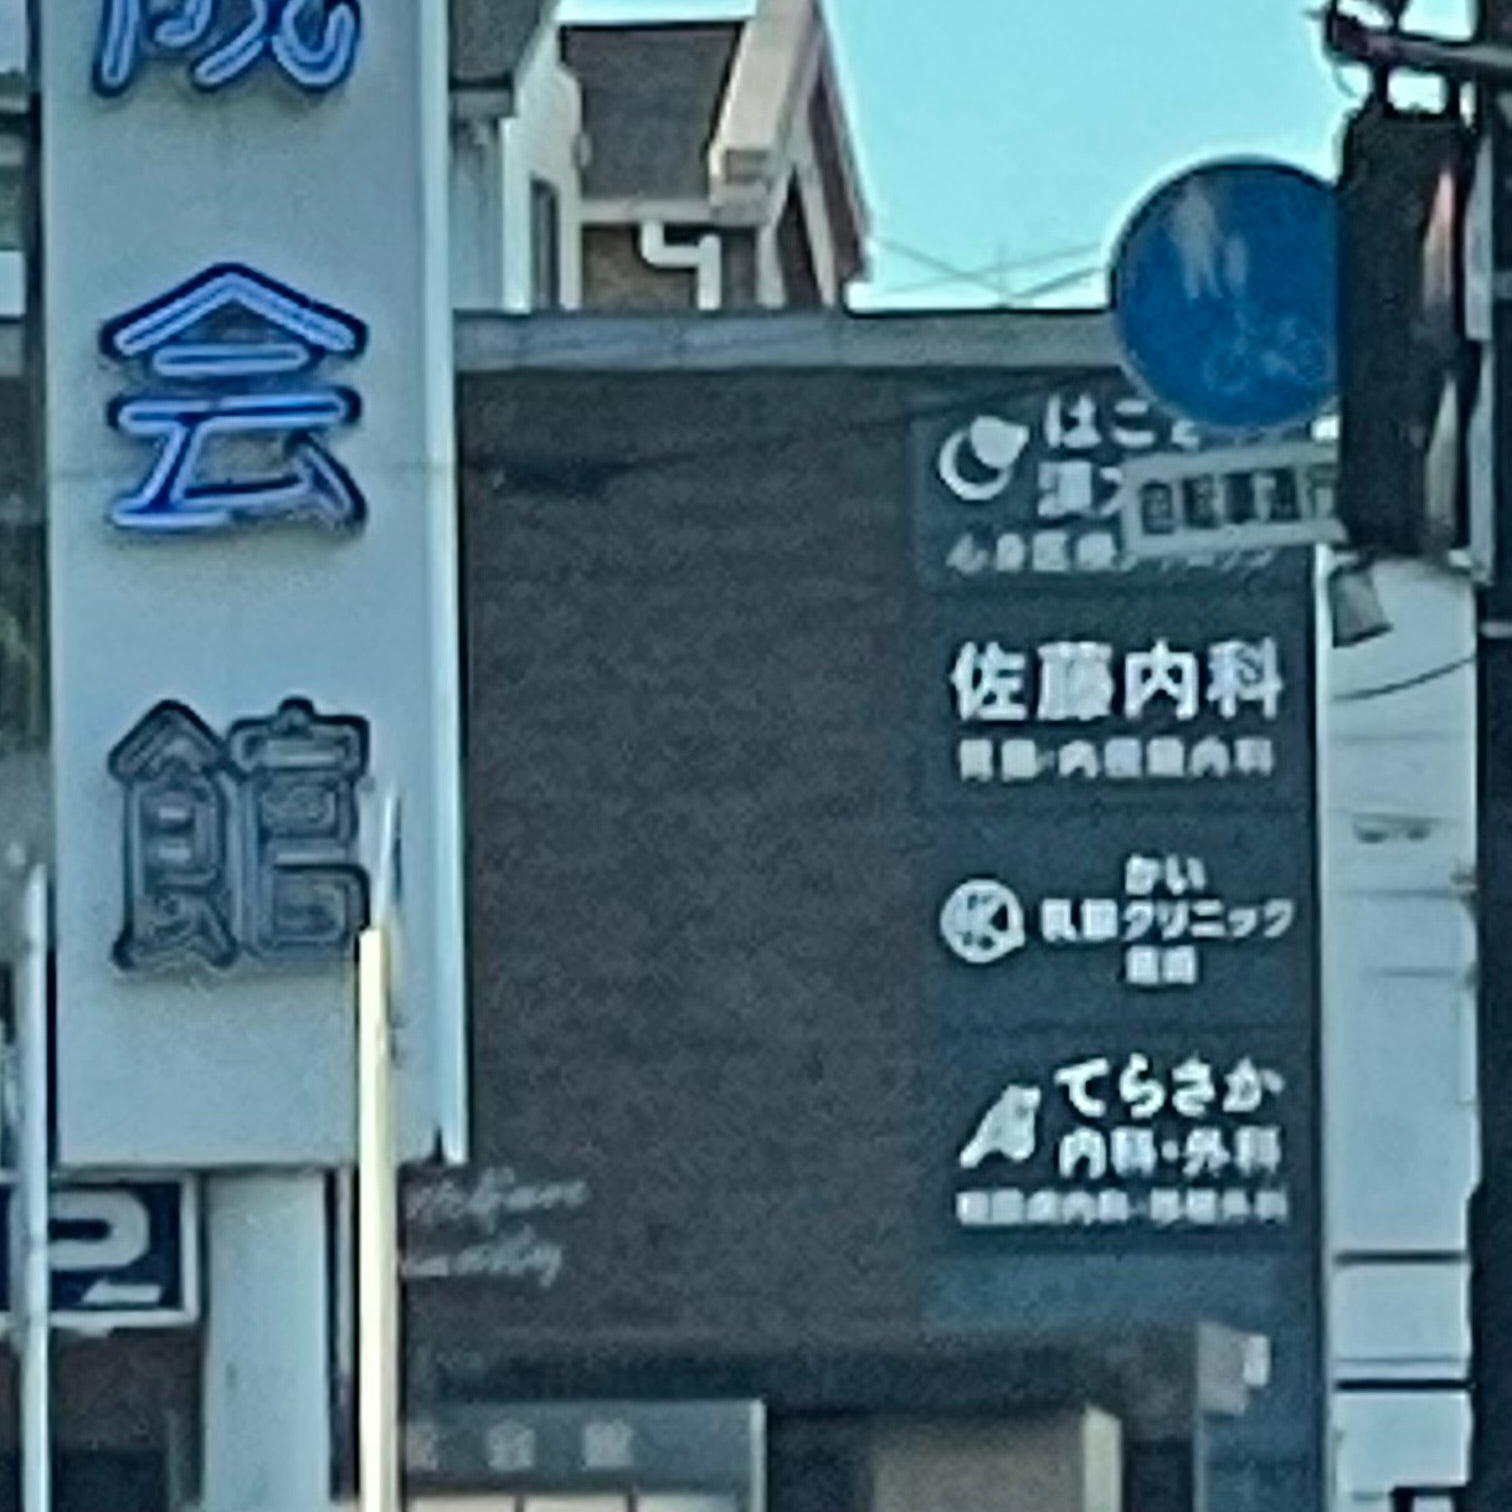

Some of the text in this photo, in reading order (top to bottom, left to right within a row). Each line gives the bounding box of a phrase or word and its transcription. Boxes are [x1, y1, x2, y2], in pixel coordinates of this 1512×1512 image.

[1043, 392, 1201, 451] はこ
[950, 637, 1284, 722] 佐藤内科
[1053, 1051, 1286, 1119] てらさか
